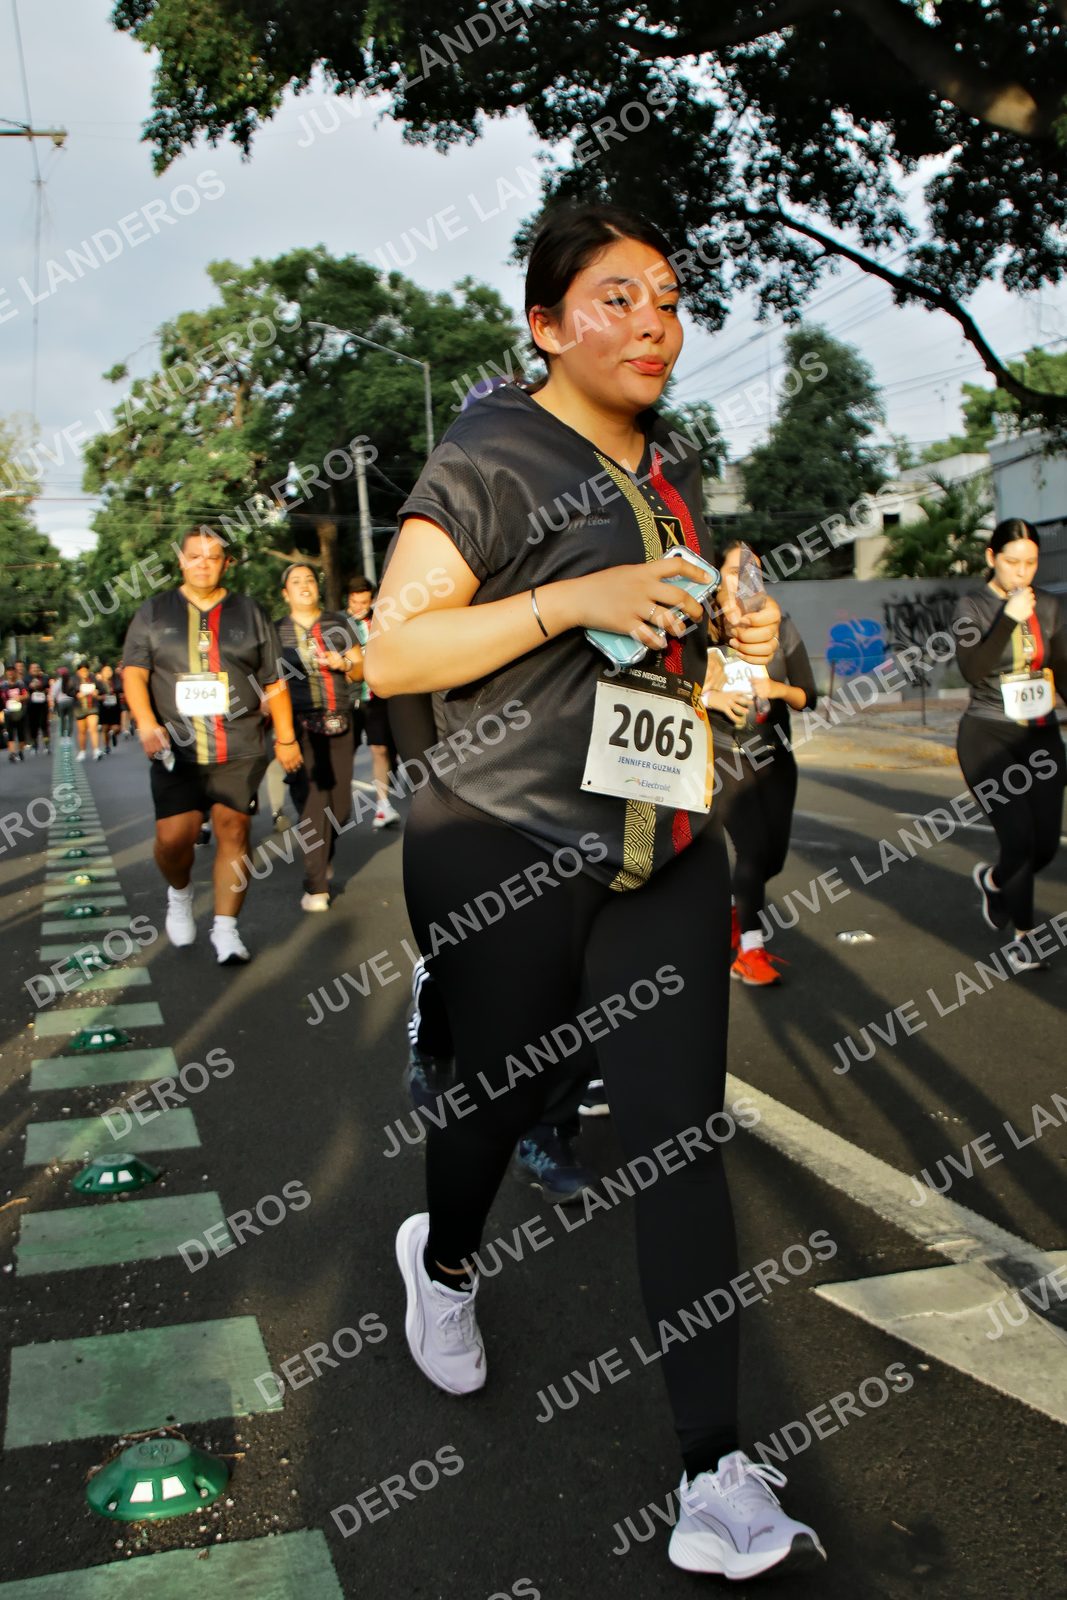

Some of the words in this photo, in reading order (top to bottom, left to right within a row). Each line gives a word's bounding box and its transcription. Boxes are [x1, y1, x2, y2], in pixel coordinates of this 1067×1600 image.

[184, 687, 217, 700] 2964
[609, 704, 694, 760] 2065
[617, 756, 651, 769] JENNIFER
